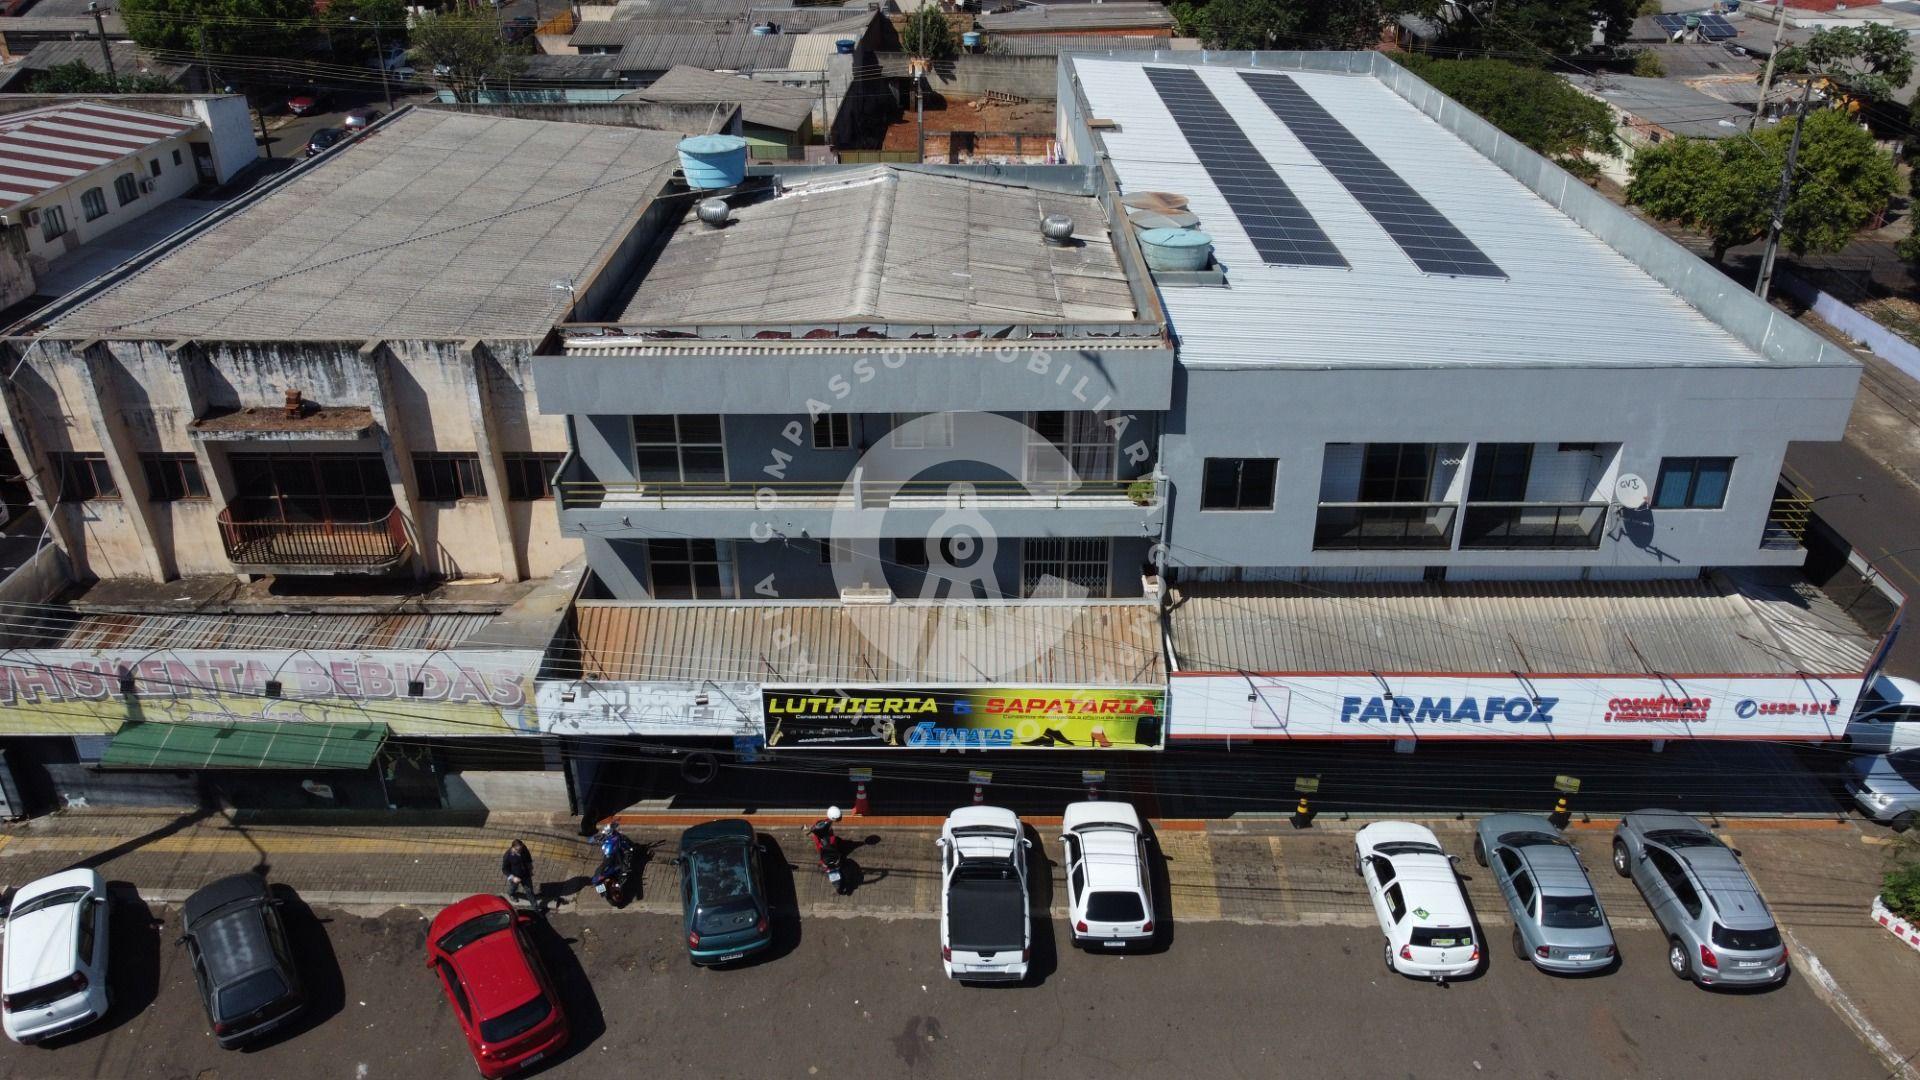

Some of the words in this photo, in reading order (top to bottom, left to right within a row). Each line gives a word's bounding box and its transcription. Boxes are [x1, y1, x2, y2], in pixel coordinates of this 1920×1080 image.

[295, 661, 526, 709] BEBIDAS
[768, 698, 938, 713] LUTHIERIA
[985, 698, 1156, 715] SAPATARIA
[1340, 696, 1560, 723] FARMAFOZ
[1608, 693, 1712, 712] COSMÉTICOS
